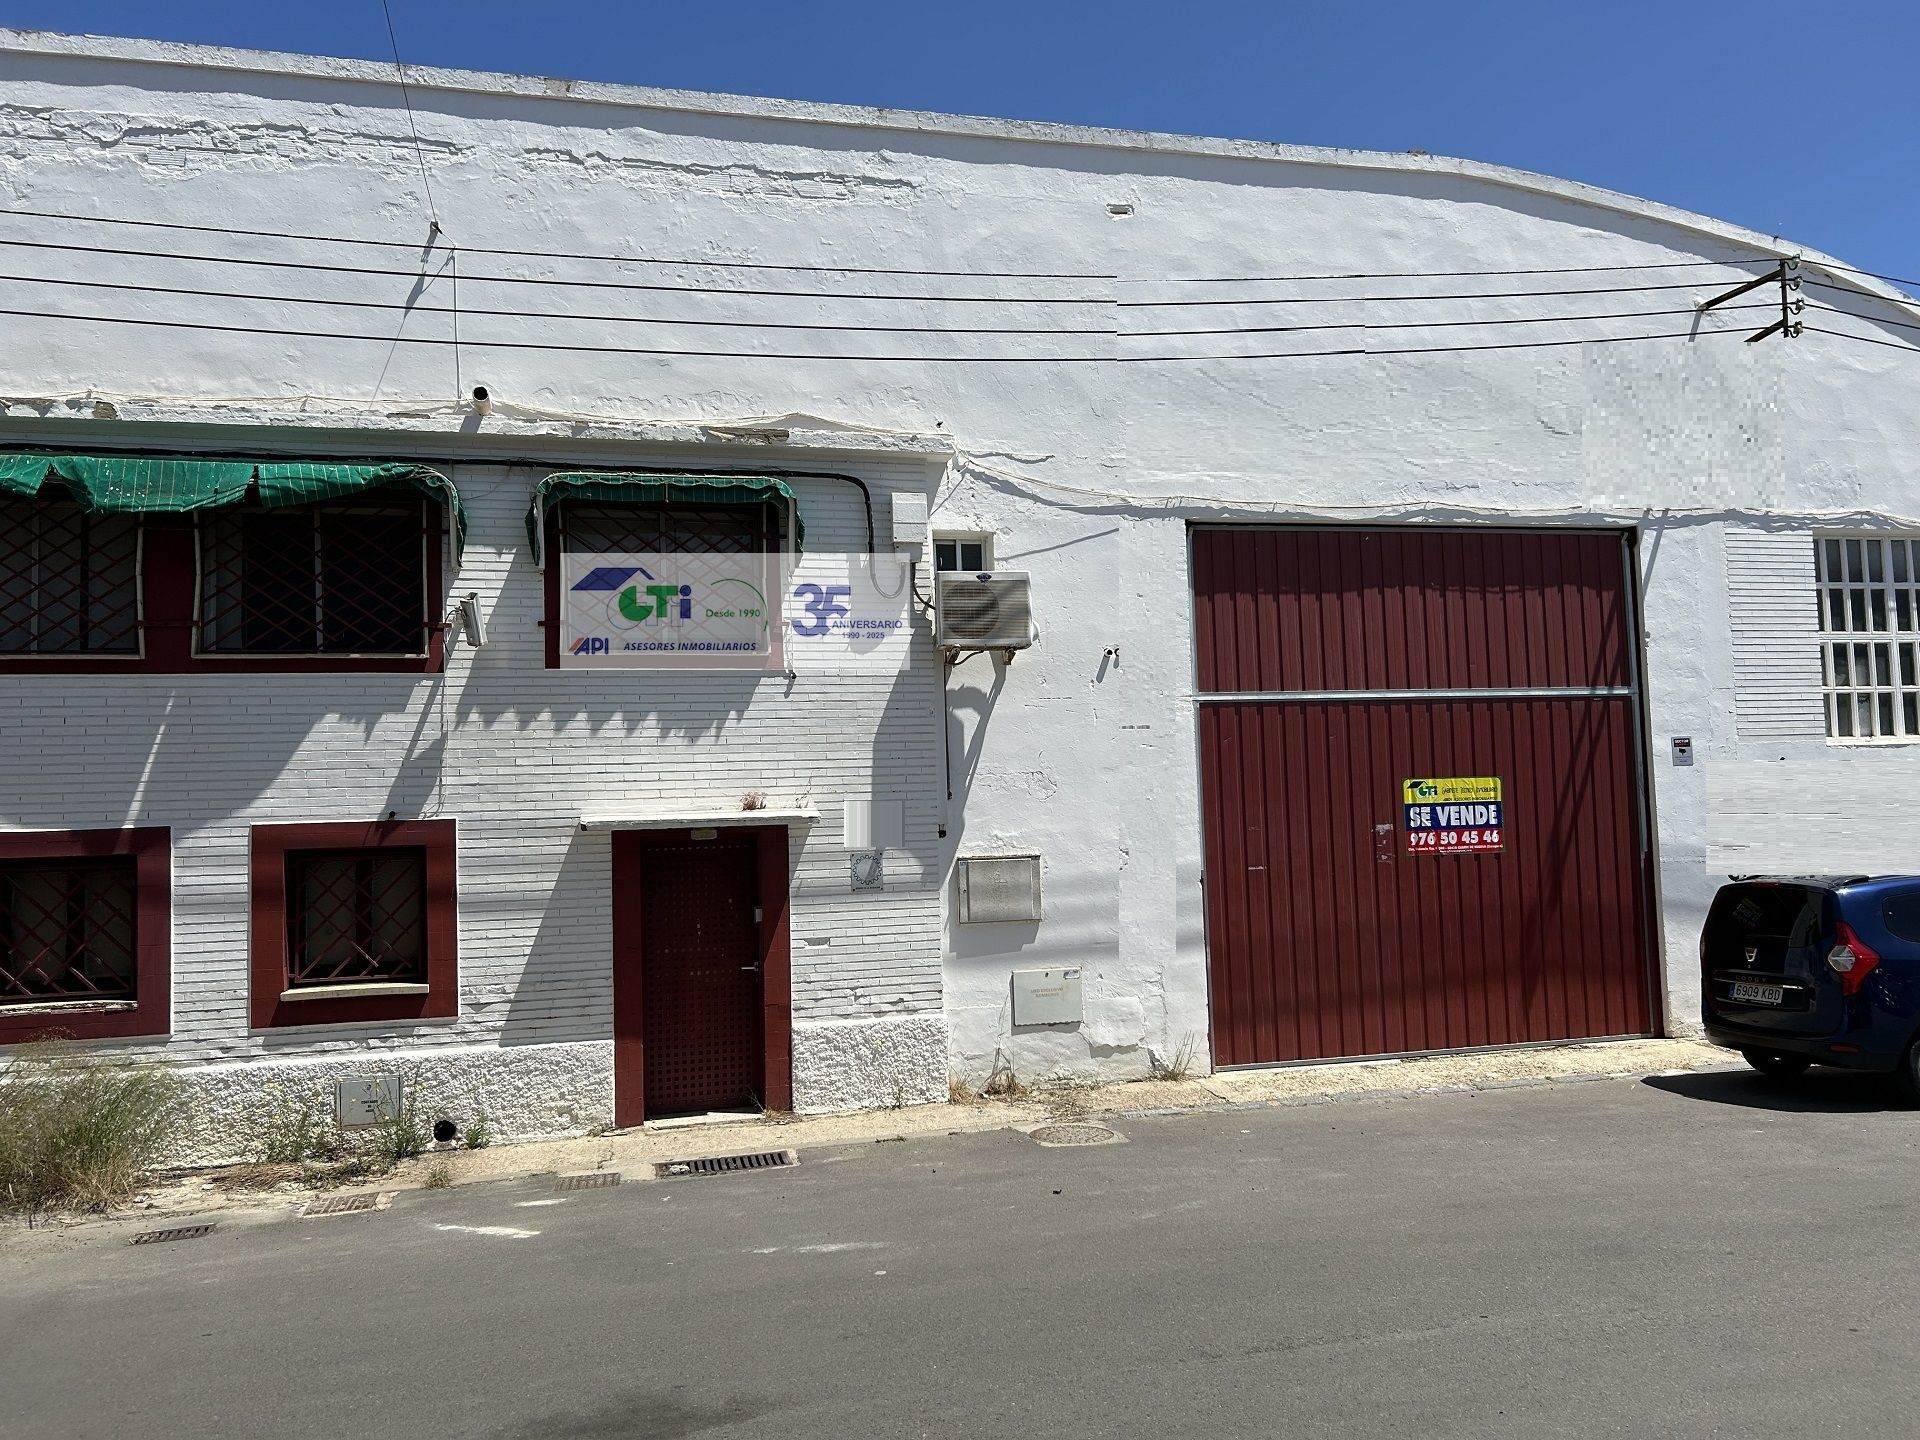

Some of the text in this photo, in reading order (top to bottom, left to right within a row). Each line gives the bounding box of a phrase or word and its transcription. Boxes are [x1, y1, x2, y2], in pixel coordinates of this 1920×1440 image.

[1409, 804, 1498, 827] SE VENDE
[1410, 829, 1500, 846] 976 50 45 46
[1736, 985, 1781, 1001] 6909 KBD
